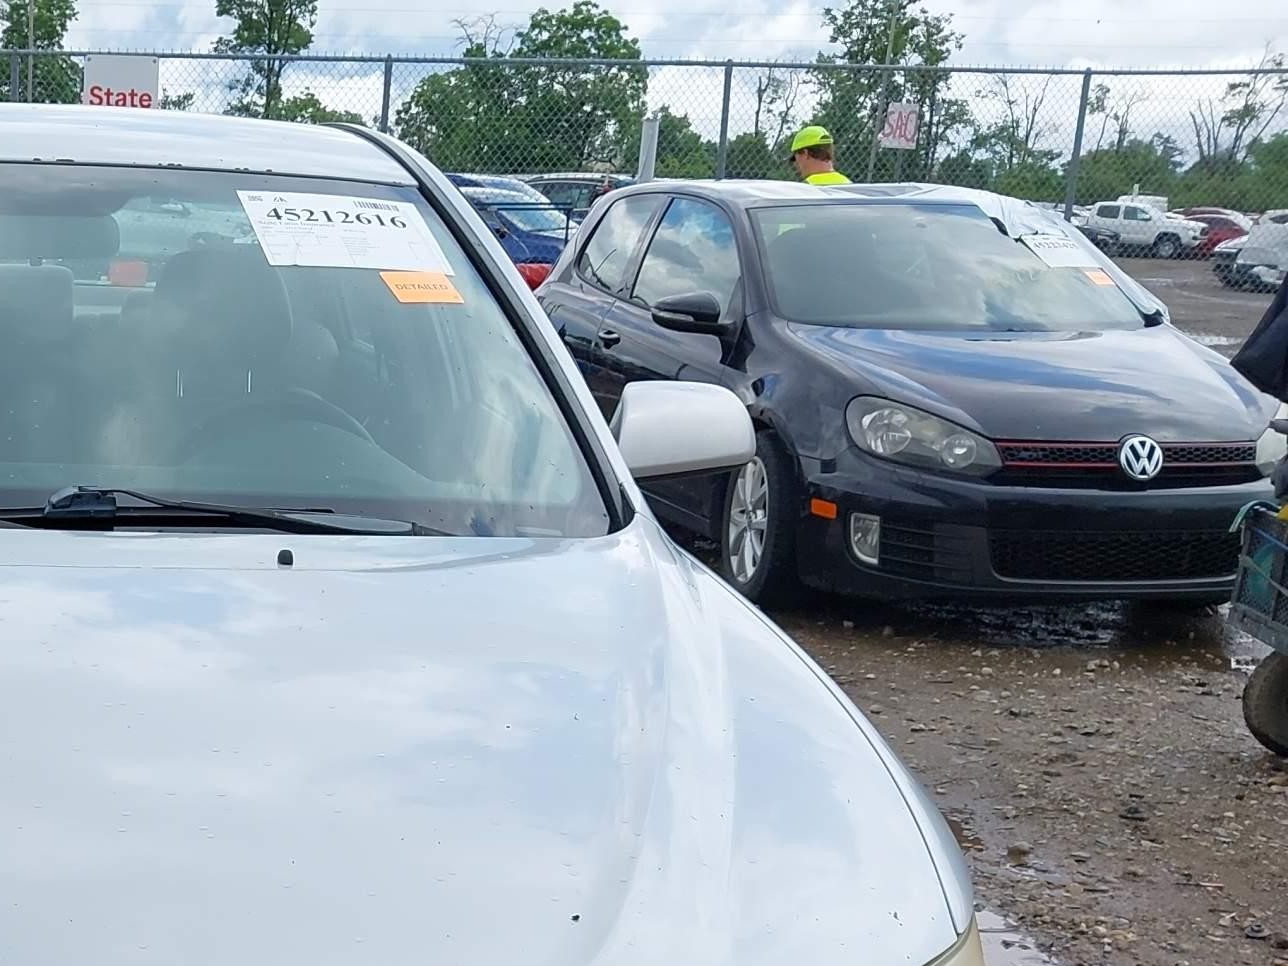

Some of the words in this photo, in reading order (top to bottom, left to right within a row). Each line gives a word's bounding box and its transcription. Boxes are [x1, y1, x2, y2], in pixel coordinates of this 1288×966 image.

[89, 86, 152, 109] State
[266, 207, 407, 229] 45212616
[394, 283, 449, 291] DETAILED
